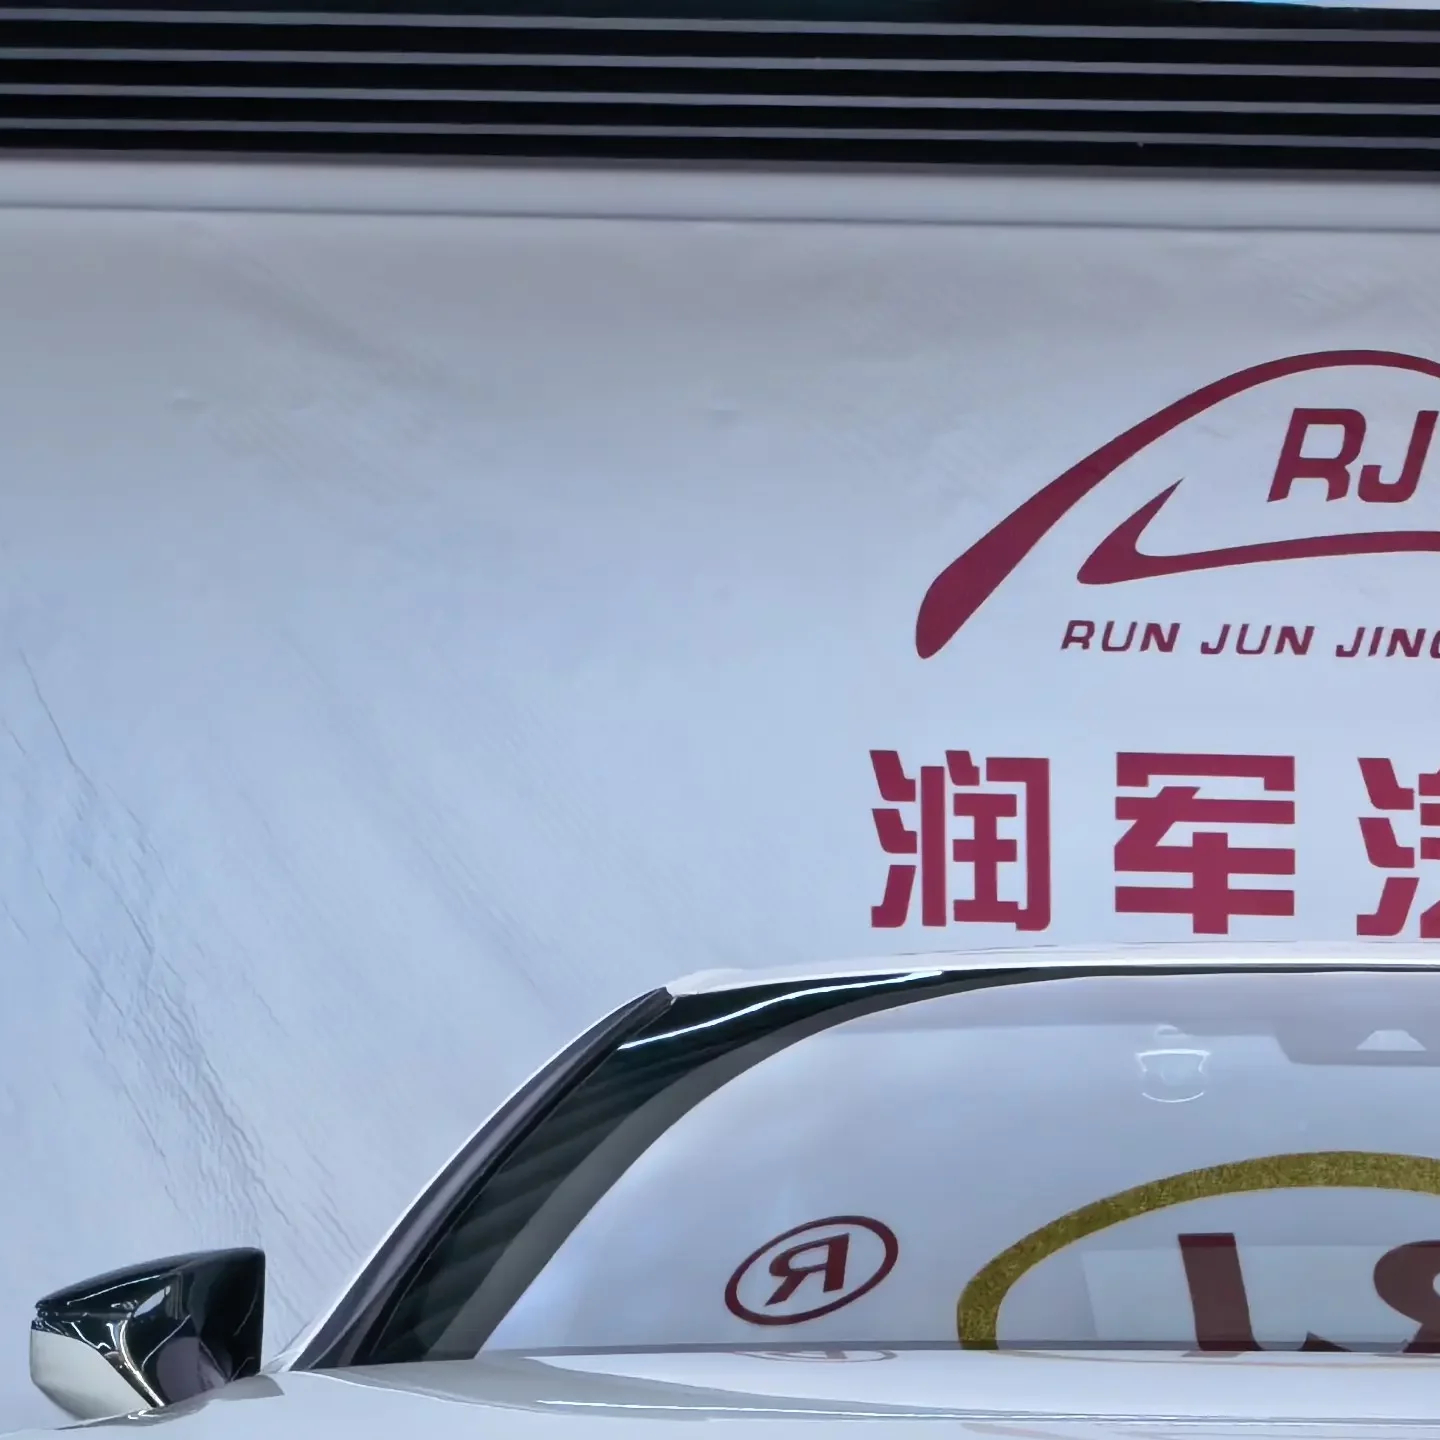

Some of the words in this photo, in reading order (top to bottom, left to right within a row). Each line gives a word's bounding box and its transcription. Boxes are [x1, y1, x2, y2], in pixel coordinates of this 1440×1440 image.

[1266, 407, 1439, 504] RJ
[1059, 619, 1181, 654] RUN
[1200, 623, 1315, 656] JUN
